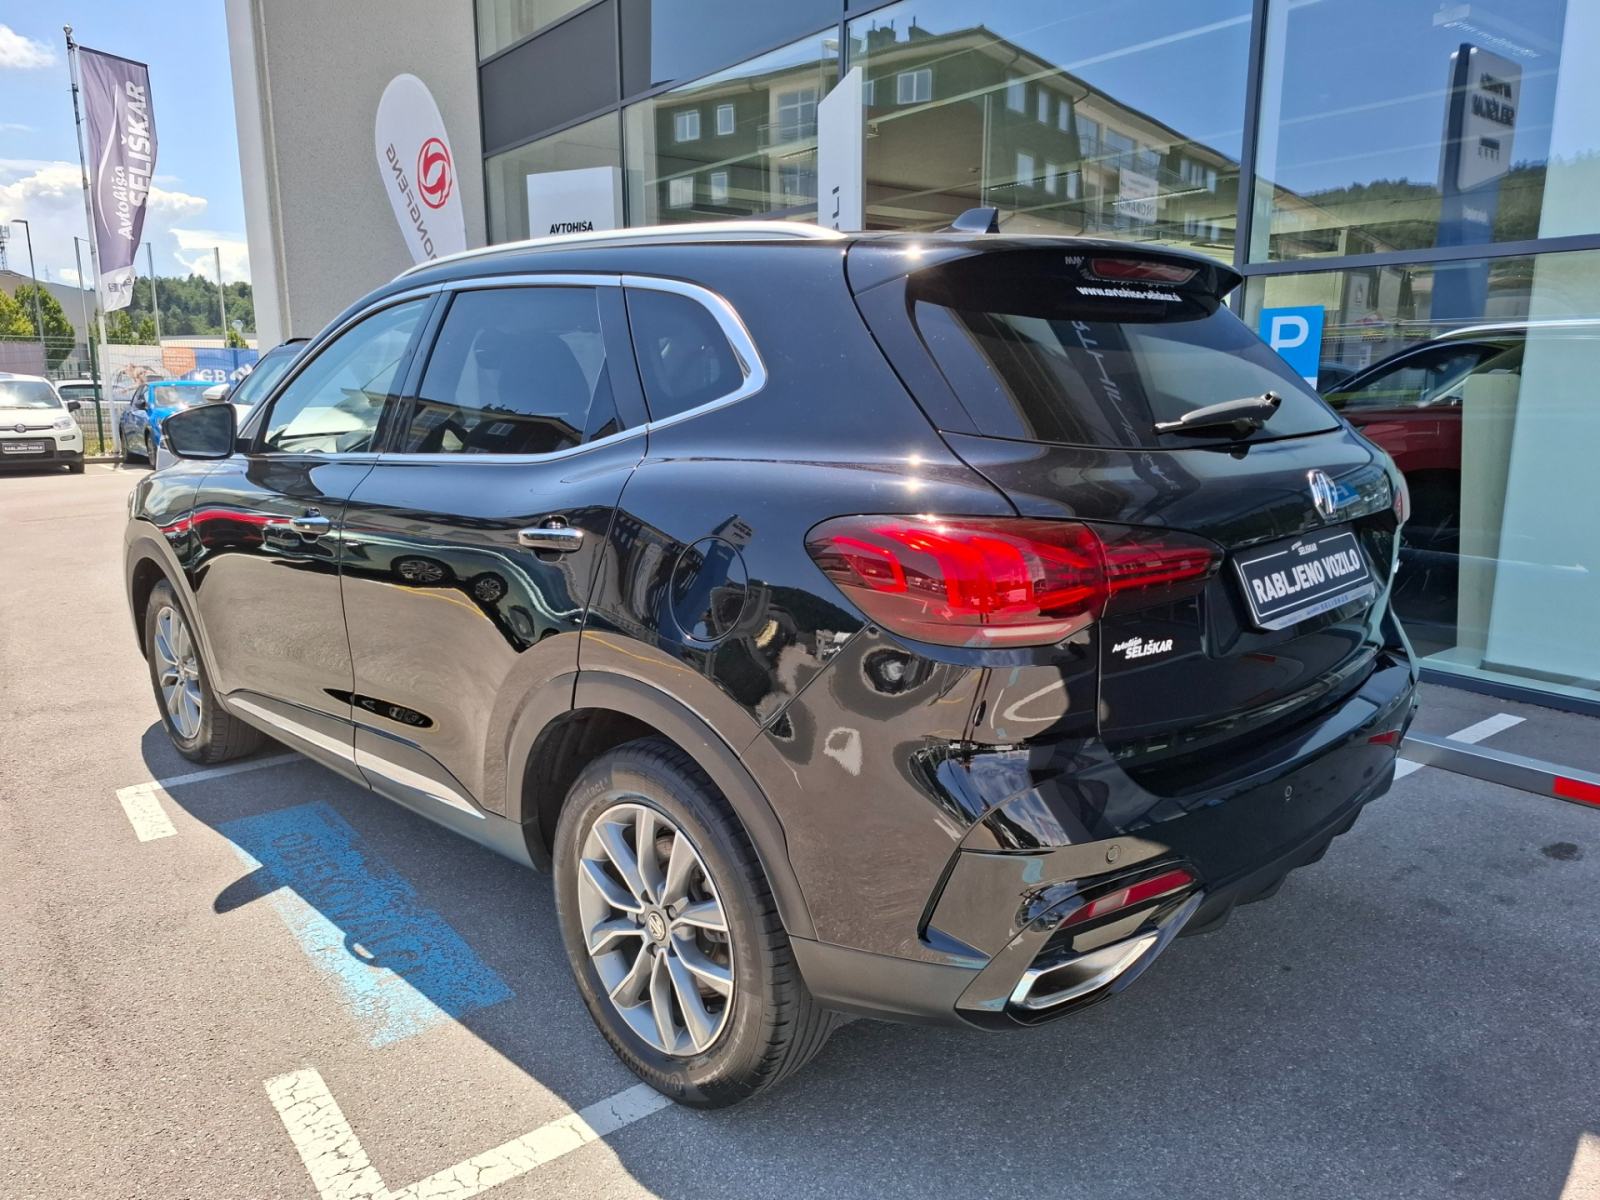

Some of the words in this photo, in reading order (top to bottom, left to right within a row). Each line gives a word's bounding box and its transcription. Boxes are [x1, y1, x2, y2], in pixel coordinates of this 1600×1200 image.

[1270, 315, 1309, 352] P
[1252, 560, 1325, 605] RABLJENO
[1321, 548, 1361, 580] VOZILO
[1125, 639, 1173, 659] SELIŠKAR
